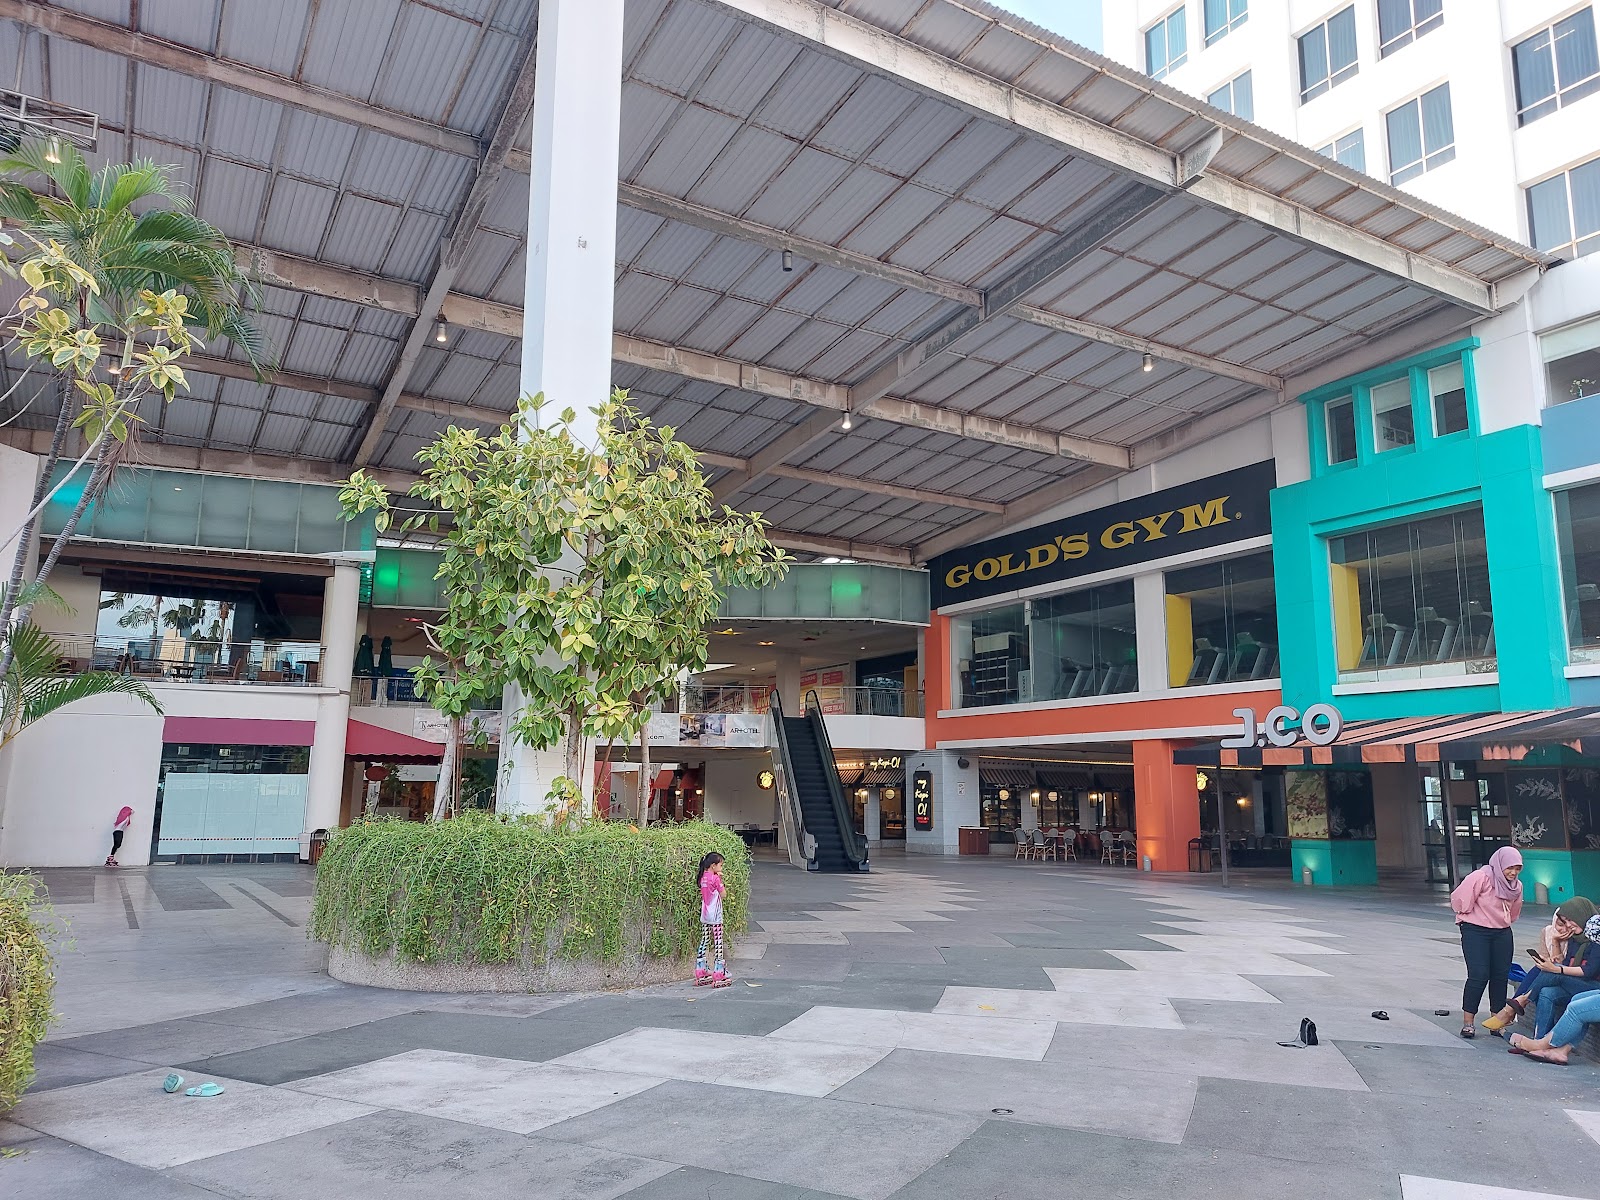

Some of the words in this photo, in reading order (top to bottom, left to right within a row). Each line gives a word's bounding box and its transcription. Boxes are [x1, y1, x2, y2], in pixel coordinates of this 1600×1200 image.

[945, 531, 1090, 589] GOLD'S
[1100, 495, 1231, 549] GYM
[1220, 703, 1344, 748] J.CO
